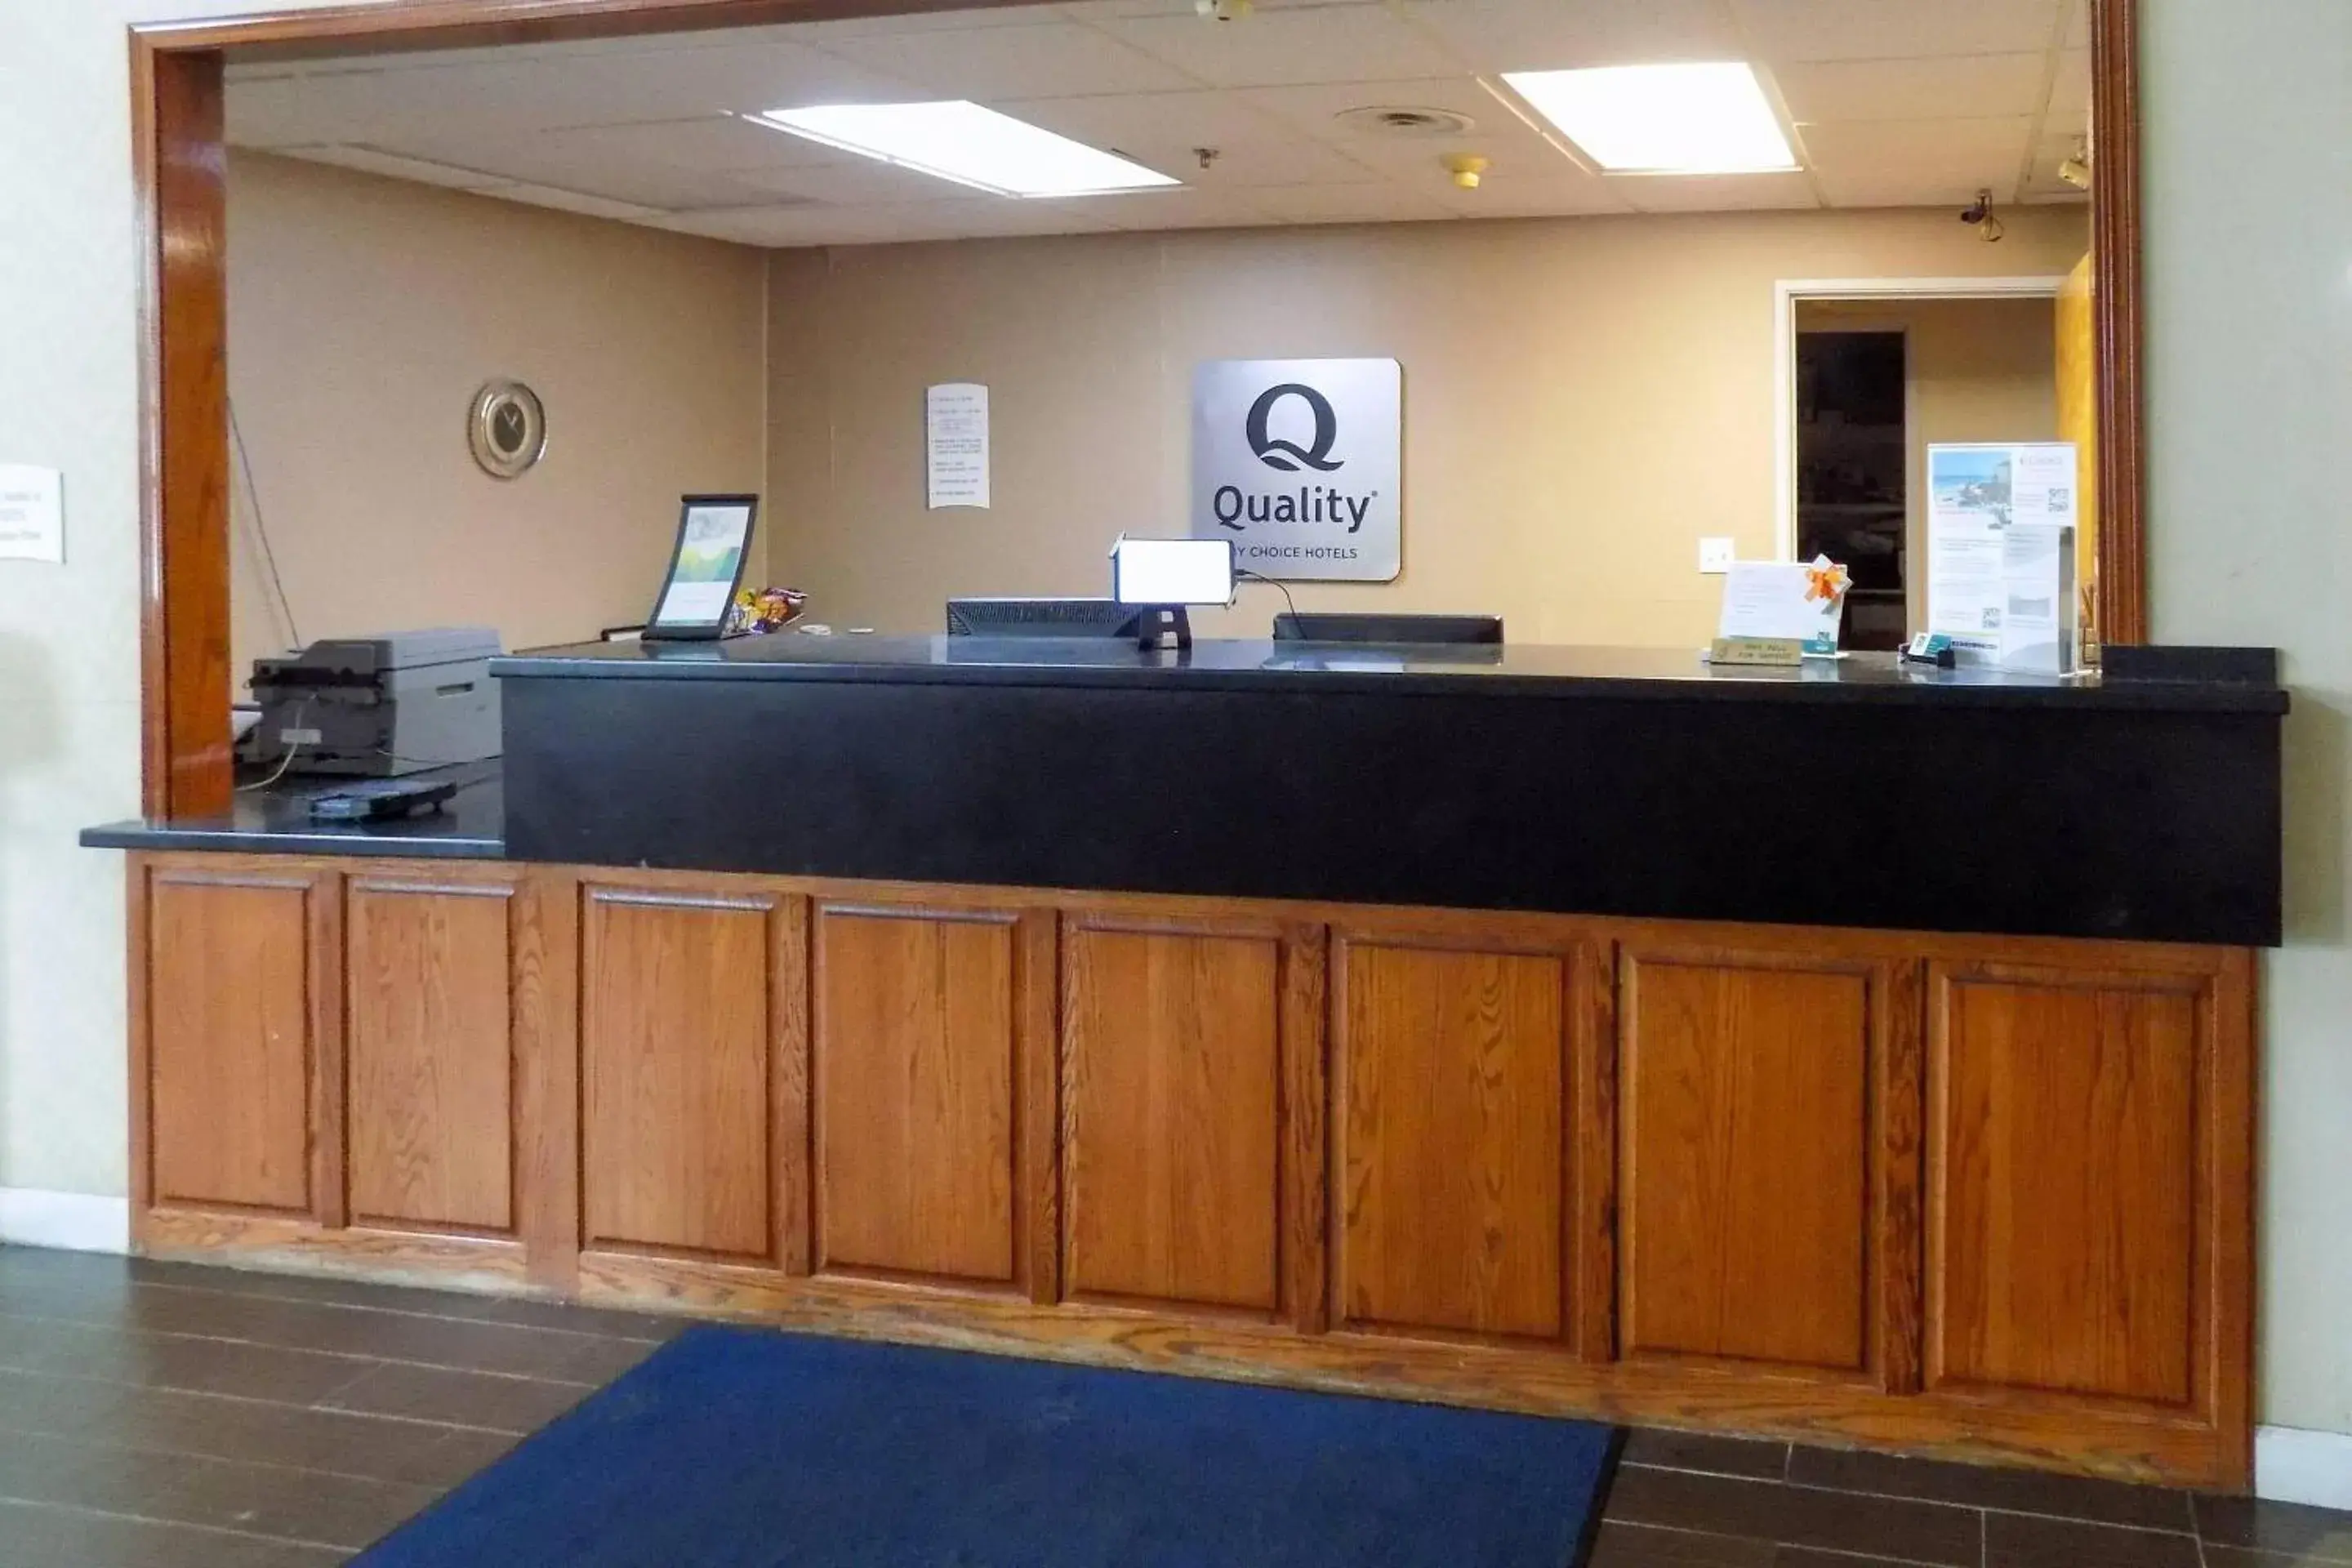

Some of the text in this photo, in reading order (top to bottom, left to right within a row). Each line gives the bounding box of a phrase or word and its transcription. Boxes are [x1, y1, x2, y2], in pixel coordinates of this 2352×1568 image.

[1246, 383, 1344, 471] Q
[1214, 485, 1370, 533] Quality
[1250, 546, 1301, 558] CHOICE
[1306, 547, 1358, 559] HOTELS
